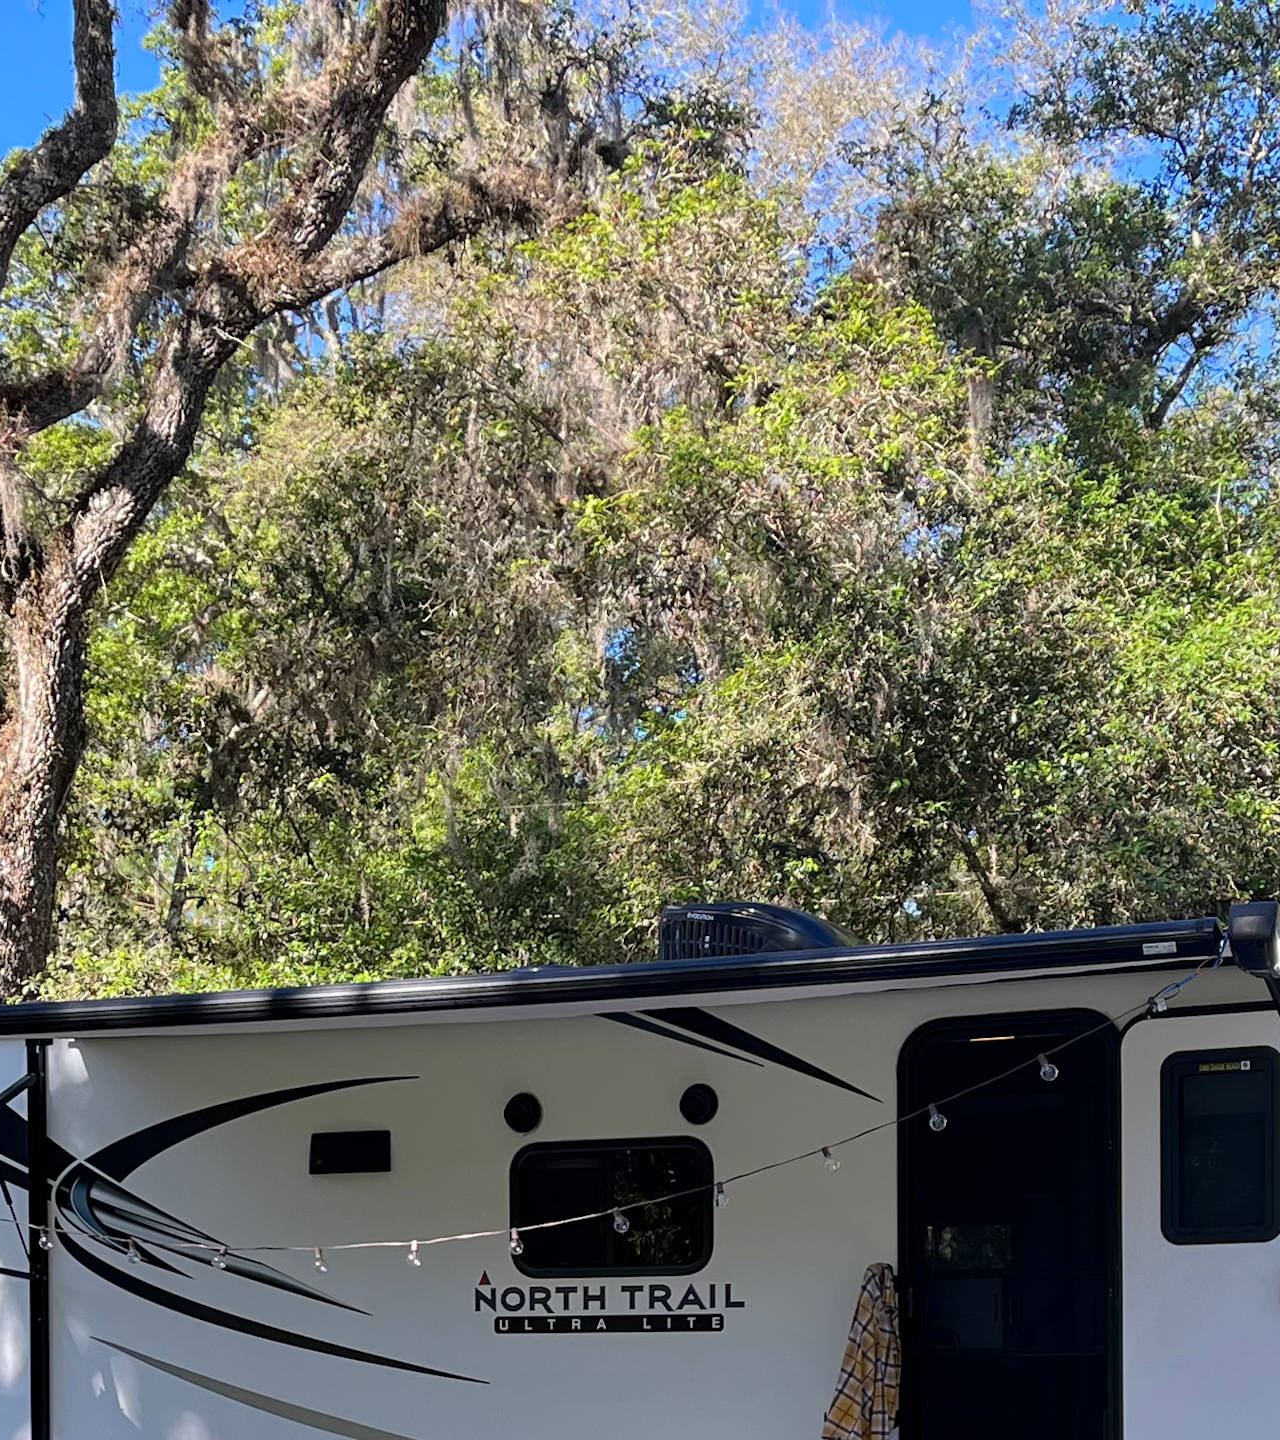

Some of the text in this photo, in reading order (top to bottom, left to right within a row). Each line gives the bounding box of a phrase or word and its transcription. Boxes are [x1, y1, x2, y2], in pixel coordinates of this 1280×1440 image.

[475, 1283, 745, 1313] NORTH TRAIL
[499, 1316, 721, 1331] ULTRA LITE
